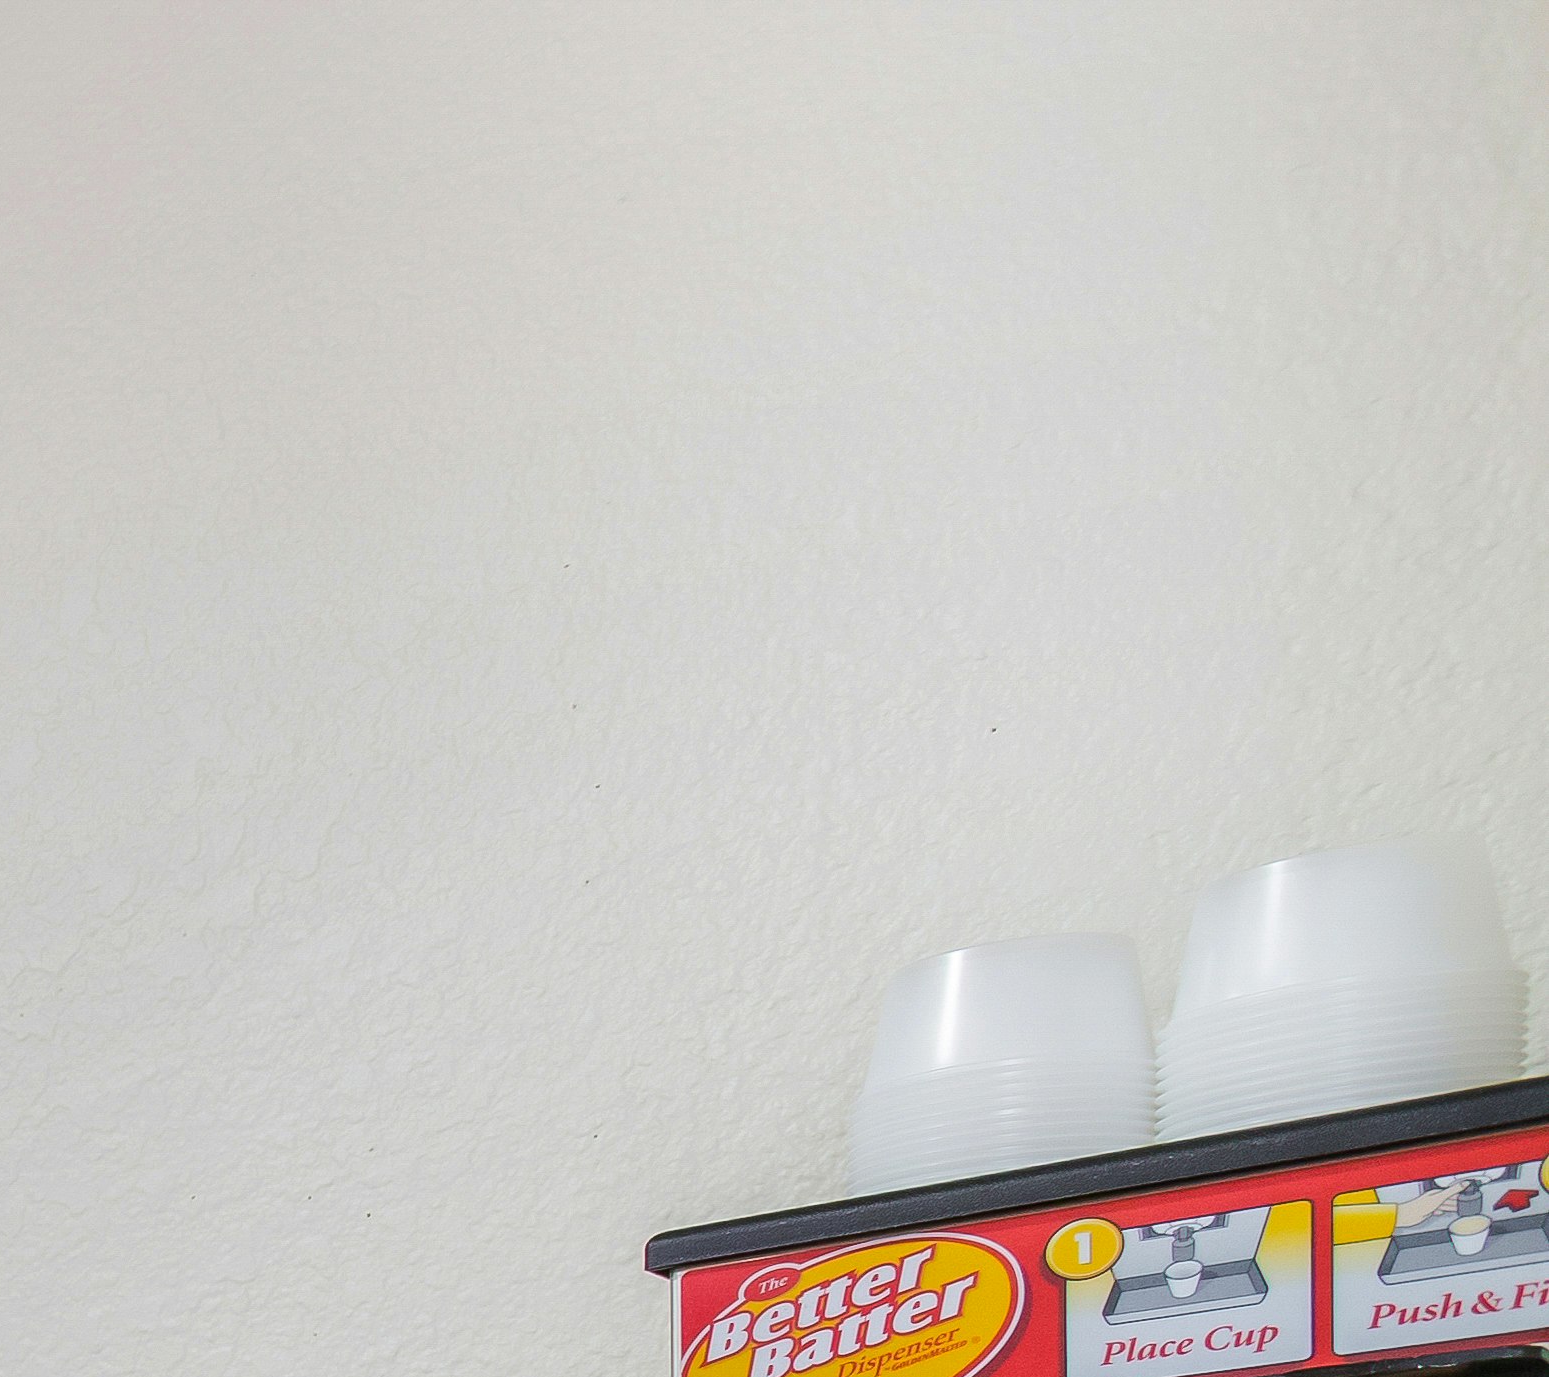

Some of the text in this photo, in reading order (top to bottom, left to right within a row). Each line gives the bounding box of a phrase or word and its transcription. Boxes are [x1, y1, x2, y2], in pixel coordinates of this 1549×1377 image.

[1072, 1233, 1094, 1265] 1
[758, 1275, 788, 1296] The
[703, 1246, 935, 1366] Better
[1367, 1292, 1463, 1330] Push
[1471, 1290, 1504, 1315] &
[1100, 1324, 1279, 1366] Place Cup
